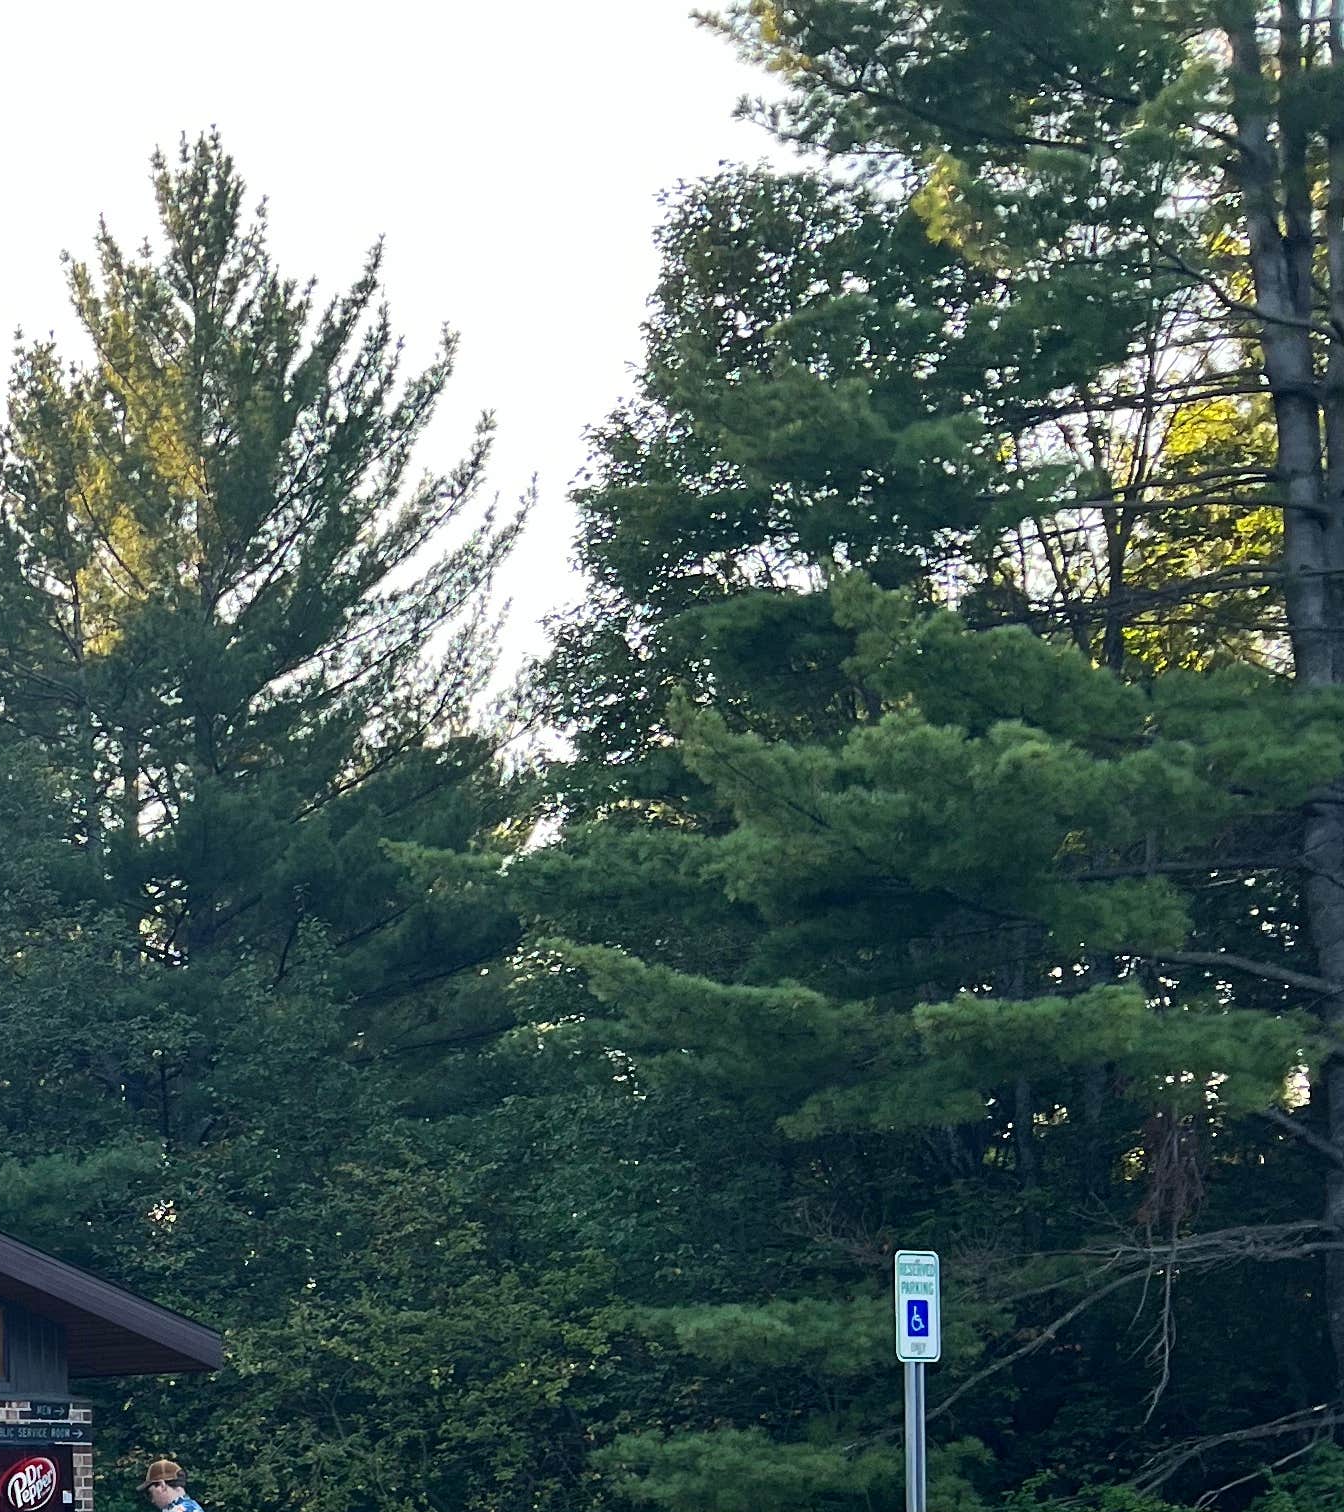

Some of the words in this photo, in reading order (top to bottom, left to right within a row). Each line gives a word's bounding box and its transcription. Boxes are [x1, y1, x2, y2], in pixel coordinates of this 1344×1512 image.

[901, 1282, 934, 1295] PARKING
[36, 1405, 51, 1415] MEN
[18, 1428, 47, 1438] SERVICE
[51, 1428, 70, 1438] ROOM
[25, 1464, 43, 1487] Dr
[7, 1470, 53, 1508] Pepper
